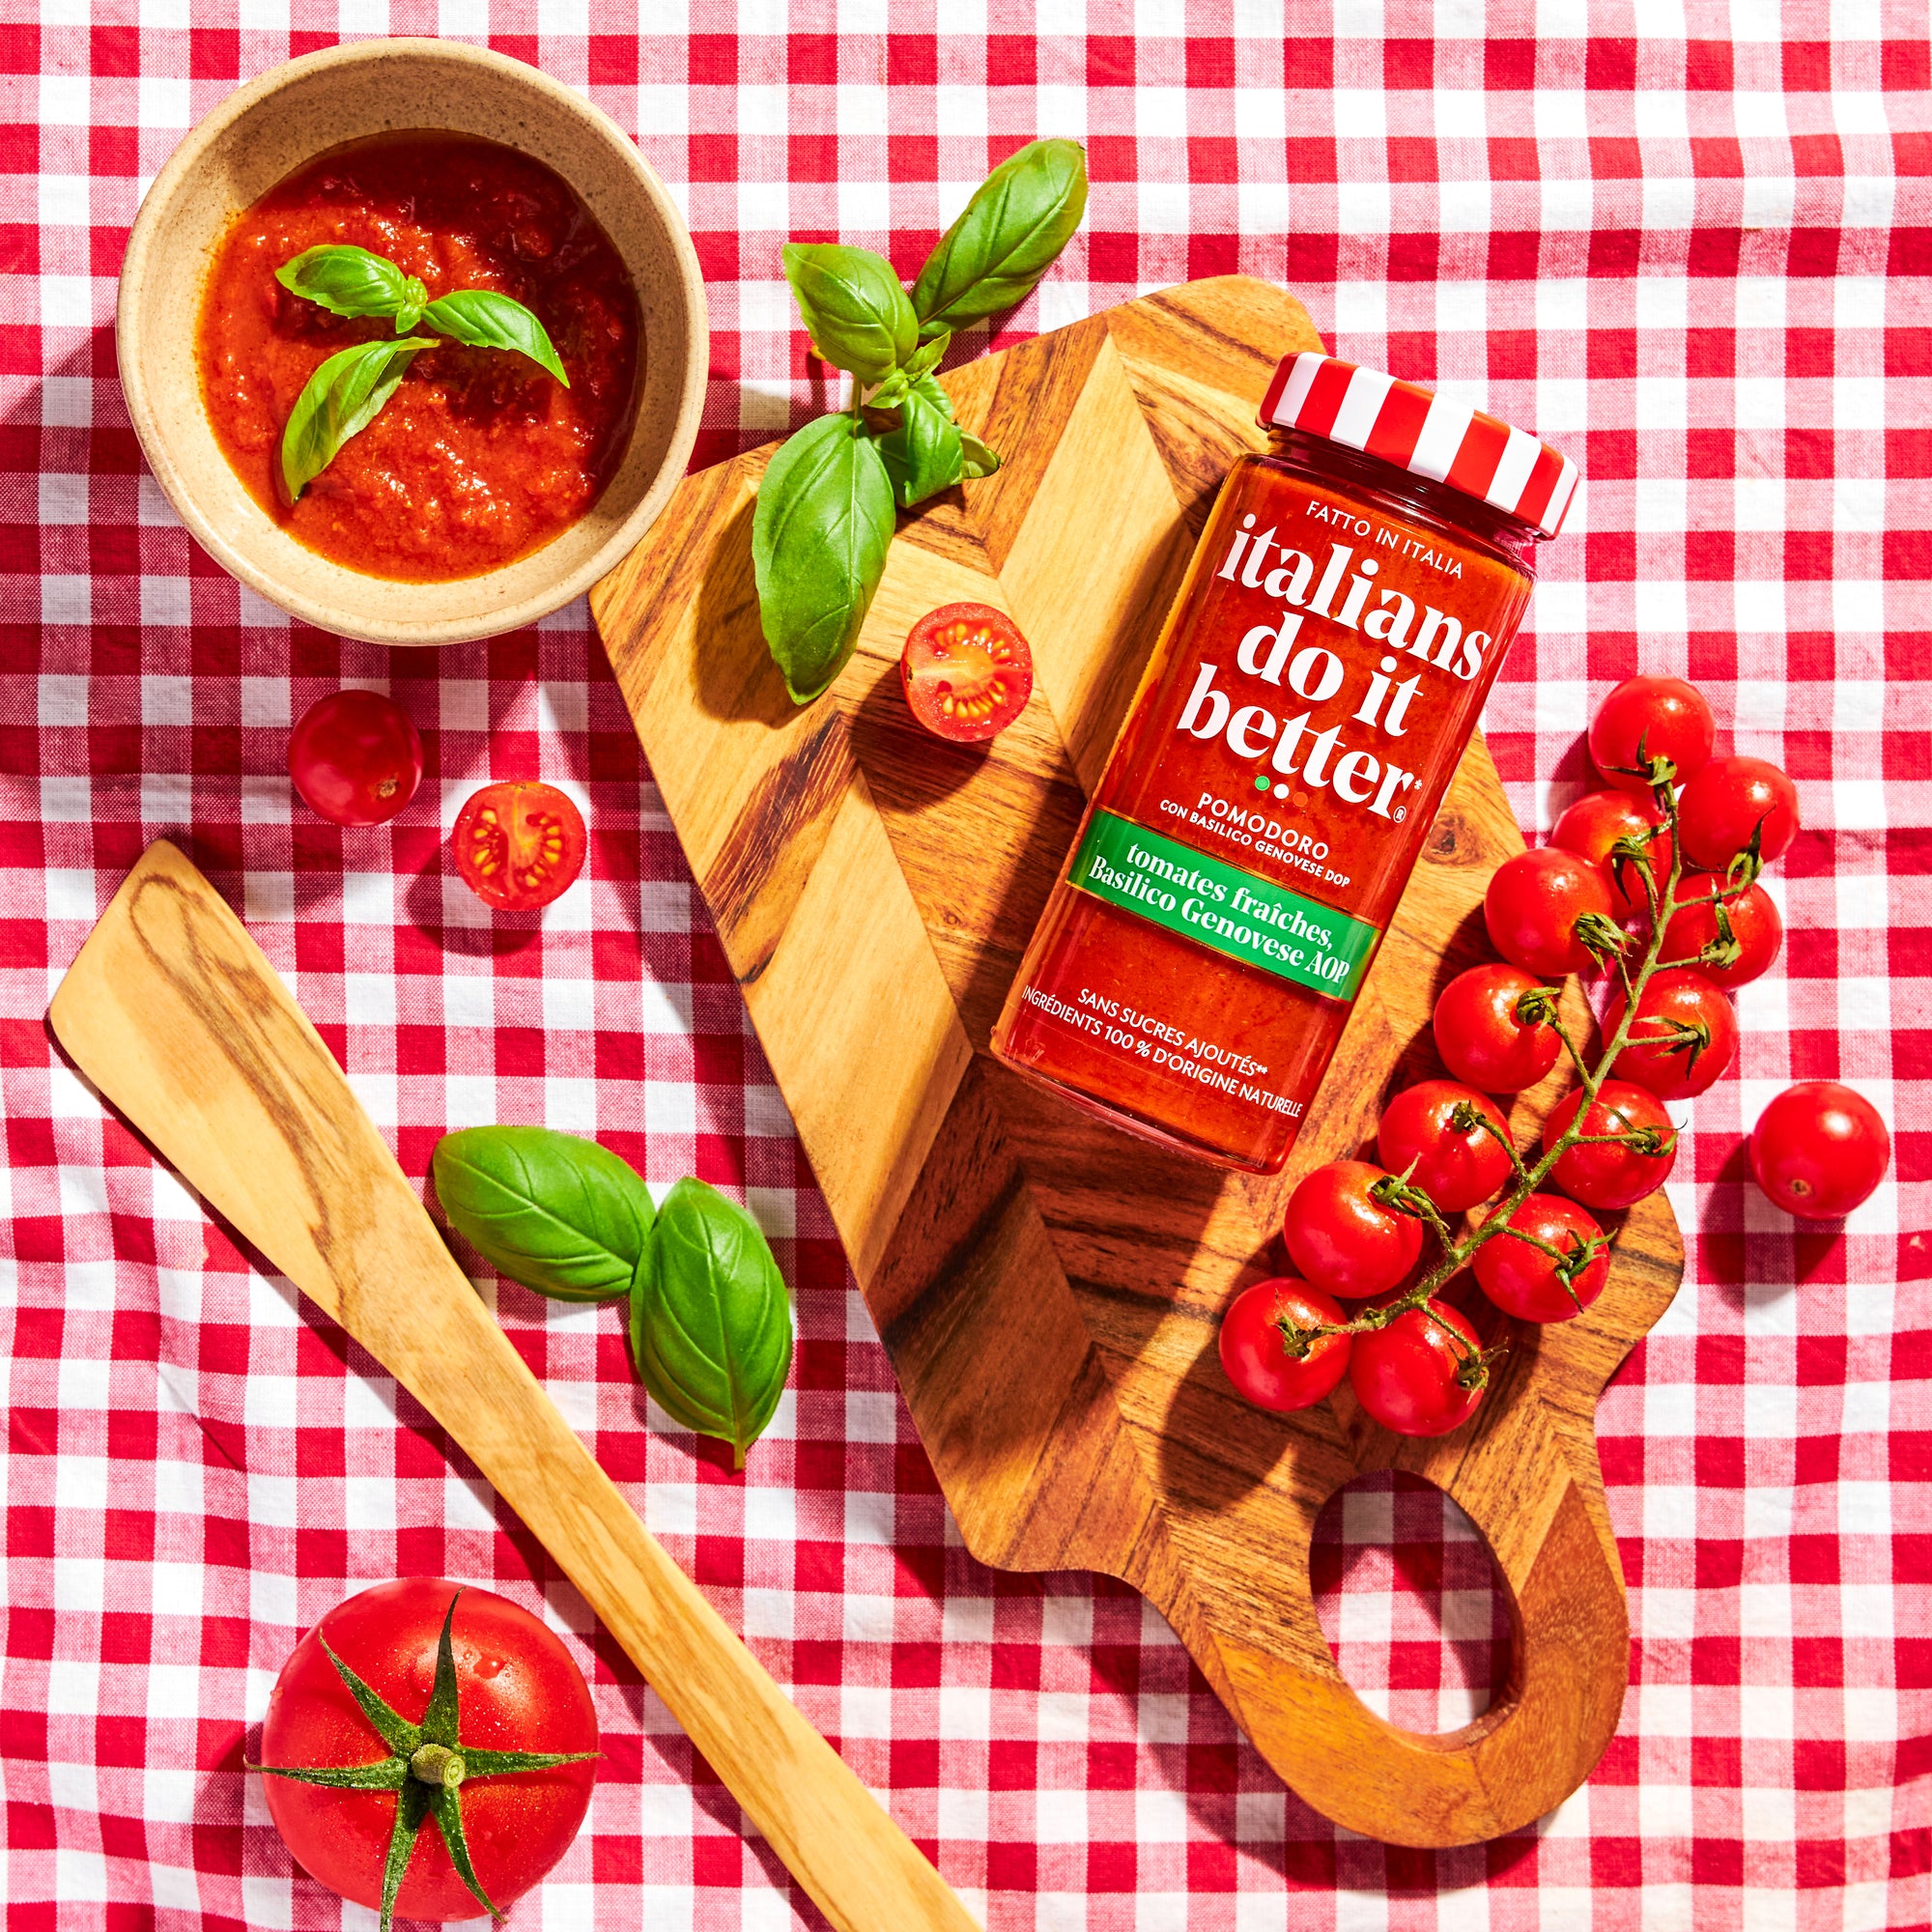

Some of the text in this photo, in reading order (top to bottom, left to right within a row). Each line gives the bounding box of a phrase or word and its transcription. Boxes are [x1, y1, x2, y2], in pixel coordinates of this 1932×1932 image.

[1306, 500, 1463, 580] FATTO IN ITALIA
[1217, 513, 1492, 681] italians
[1236, 611, 1424, 737] do it
[1159, 799, 1350, 888] CON BASILICO GENOVESE DOP
[1197, 792, 1329, 860] POMODORO
[1088, 856, 1351, 984] Basilico Genovese AOP
[1125, 842, 1333, 952] tomates fraîches,
[1021, 985, 1303, 1118] INGRÉDIENTS 100 % D'ORIGINE NATURELLE
[1077, 988, 1120, 1018] SANS
[1120, 1008, 1186, 1047] SUCRES
